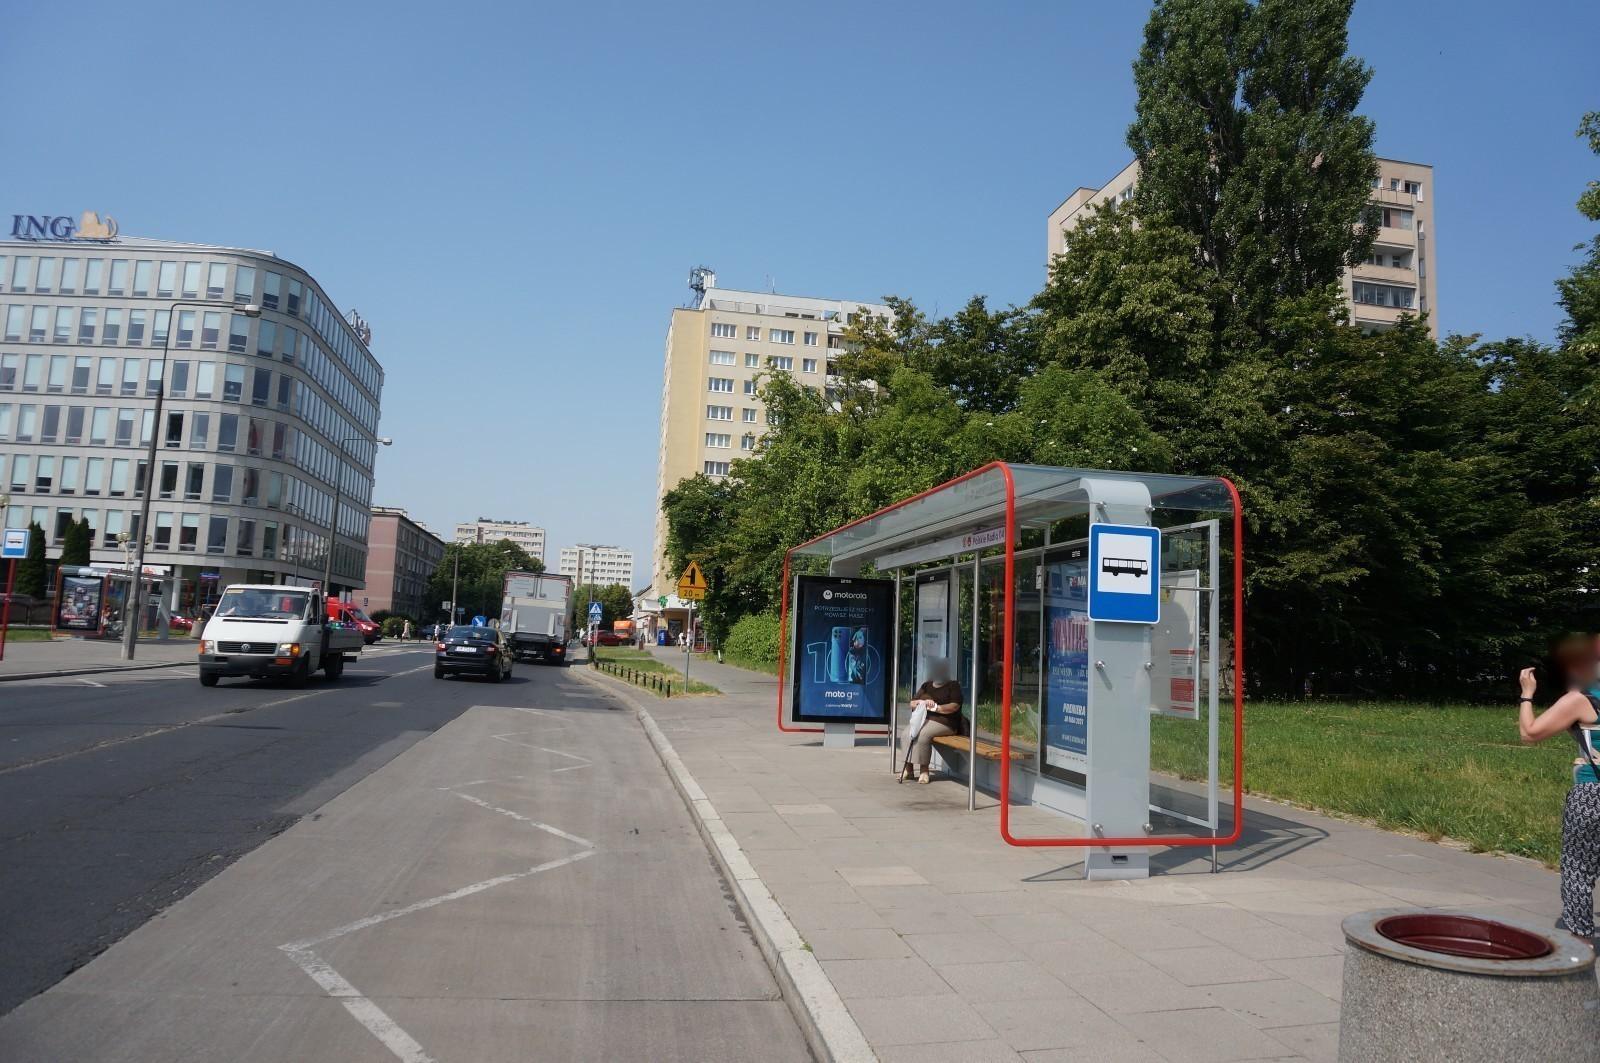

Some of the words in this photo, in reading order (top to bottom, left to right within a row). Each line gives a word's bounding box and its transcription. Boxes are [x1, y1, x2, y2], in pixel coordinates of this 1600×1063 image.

[10, 215, 76, 238] ING
[825, 690, 845, 698] moto
[1063, 702, 1086, 716] PREMIERA
